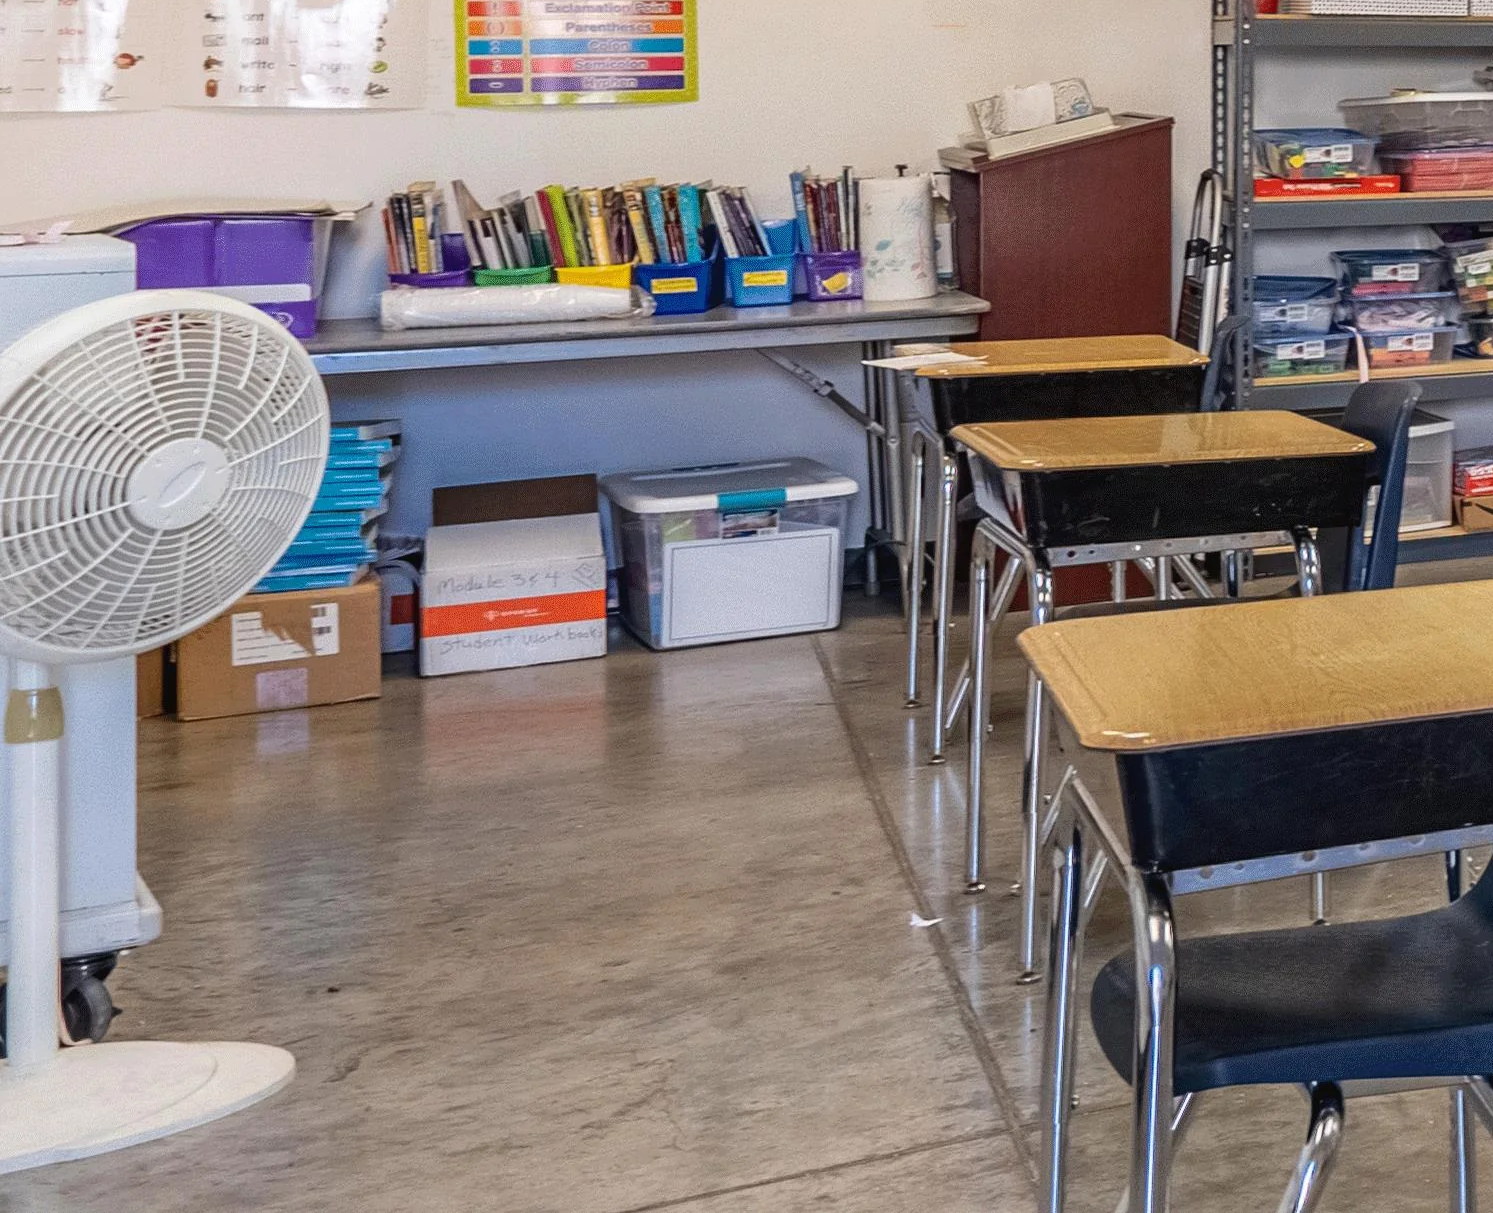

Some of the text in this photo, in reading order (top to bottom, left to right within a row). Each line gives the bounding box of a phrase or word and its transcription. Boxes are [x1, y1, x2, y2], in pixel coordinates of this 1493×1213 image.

[545, 3, 631, 13] Exclamation
[511, 574, 523, 585] 3
[545, 572, 560, 587] 4
